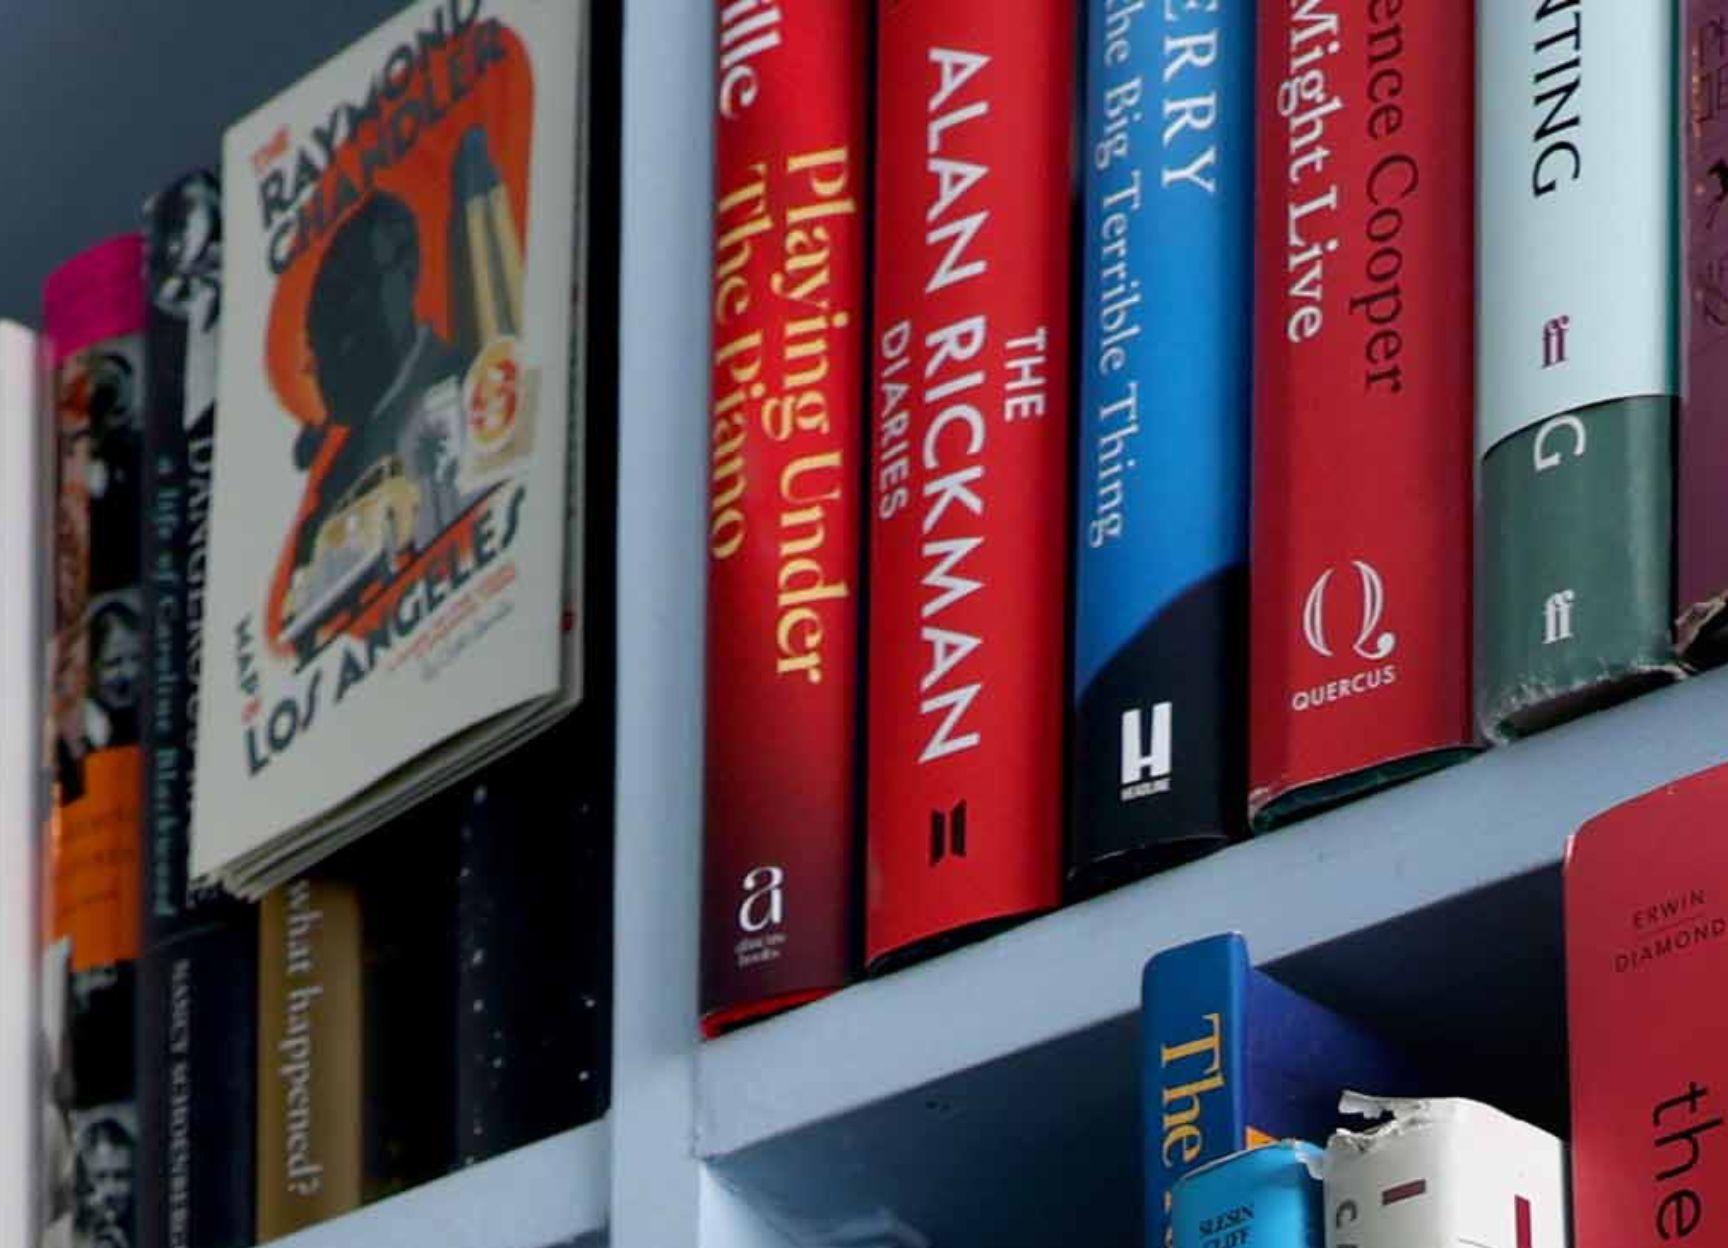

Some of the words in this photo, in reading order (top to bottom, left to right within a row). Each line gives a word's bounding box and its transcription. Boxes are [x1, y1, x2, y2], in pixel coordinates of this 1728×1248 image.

[258, 0, 481, 231] RAYMOND
[1096, 77, 1142, 170] Big
[1104, 0, 1143, 66] he
[1277, 0, 1343, 183] Might
[268, 17, 507, 274] CHANDLER
[926, 47, 992, 294] ALAN
[717, 162, 773, 320] The
[762, 146, 855, 436] Playing
[1098, 171, 1144, 378] Terrible
[1287, 190, 1339, 343] Live
[1347, 152, 1420, 394] Cooper
[709, 336, 771, 560] Piano
[878, 321, 912, 520] DIARIES
[1005, 326, 1047, 421] THE
[917, 315, 989, 764] RICKMAN
[1089, 383, 1141, 548] Thing
[247, 664, 323, 777] LOS
[334, 484, 526, 705] ANGELES
[774, 446, 849, 685] Under
[1291, 665, 1396, 711] QUERCUS
[286, 878, 324, 976] what
[1614, 916, 1727, 976] DIAMOND
[1631, 888, 1706, 931] ERWIN
[280, 986, 324, 1199] happened?
[1158, 1014, 1231, 1168] The
[1652, 1079, 1723, 1242] the
